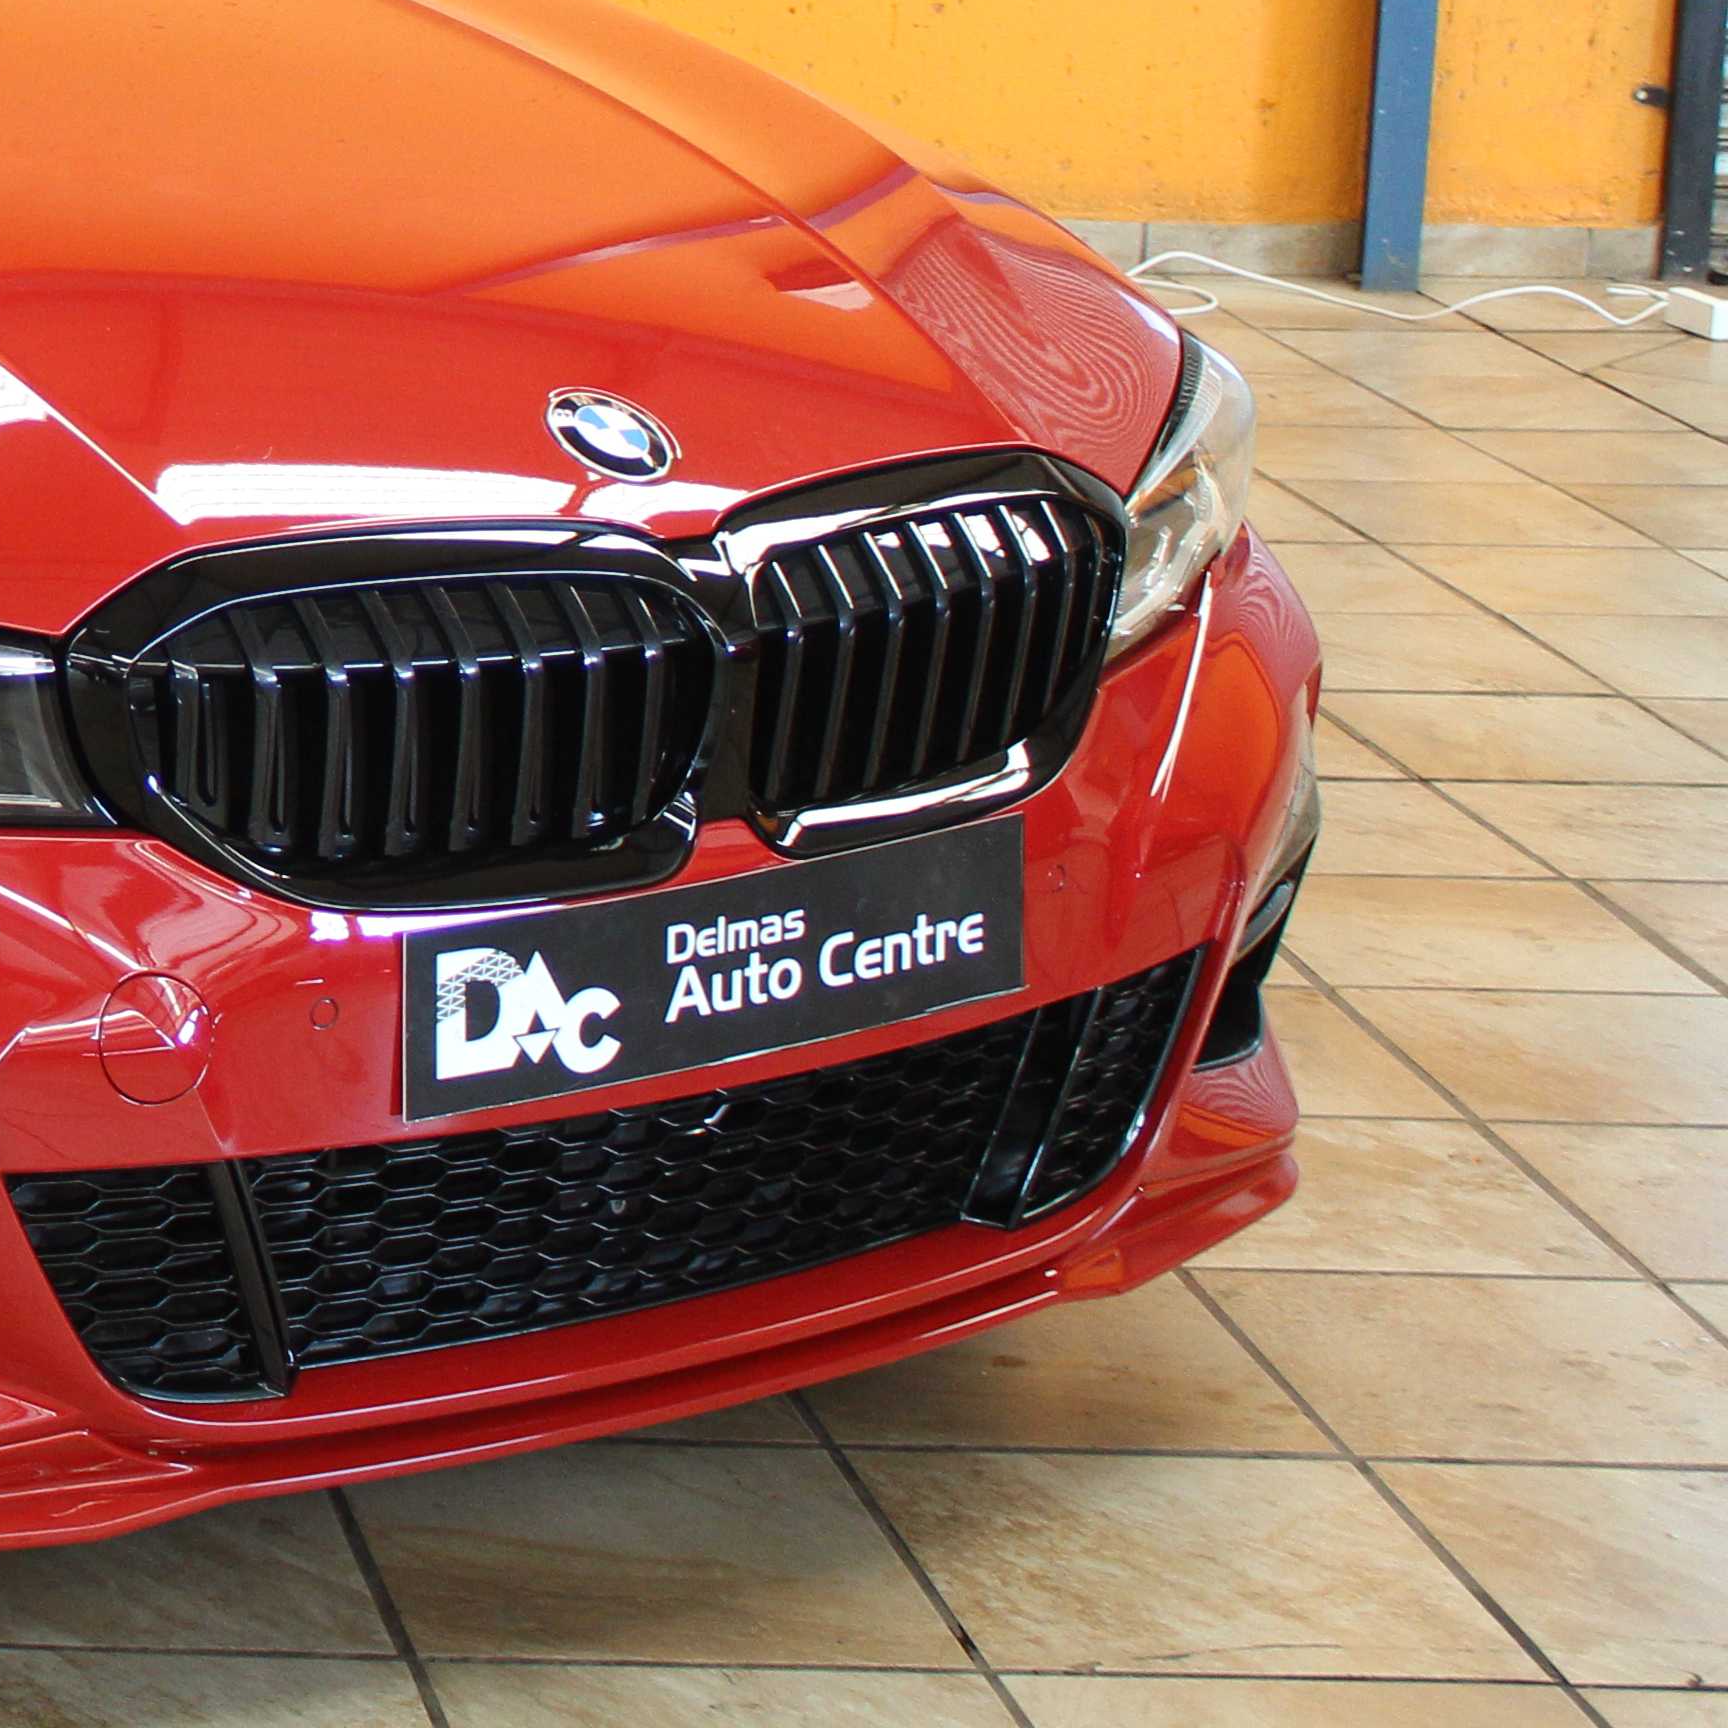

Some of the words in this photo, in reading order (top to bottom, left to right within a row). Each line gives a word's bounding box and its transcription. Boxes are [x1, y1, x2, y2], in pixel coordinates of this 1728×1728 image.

[665, 907, 806, 965] Delmas
[665, 951, 803, 1024] Auto
[819, 913, 985, 987] Centre
